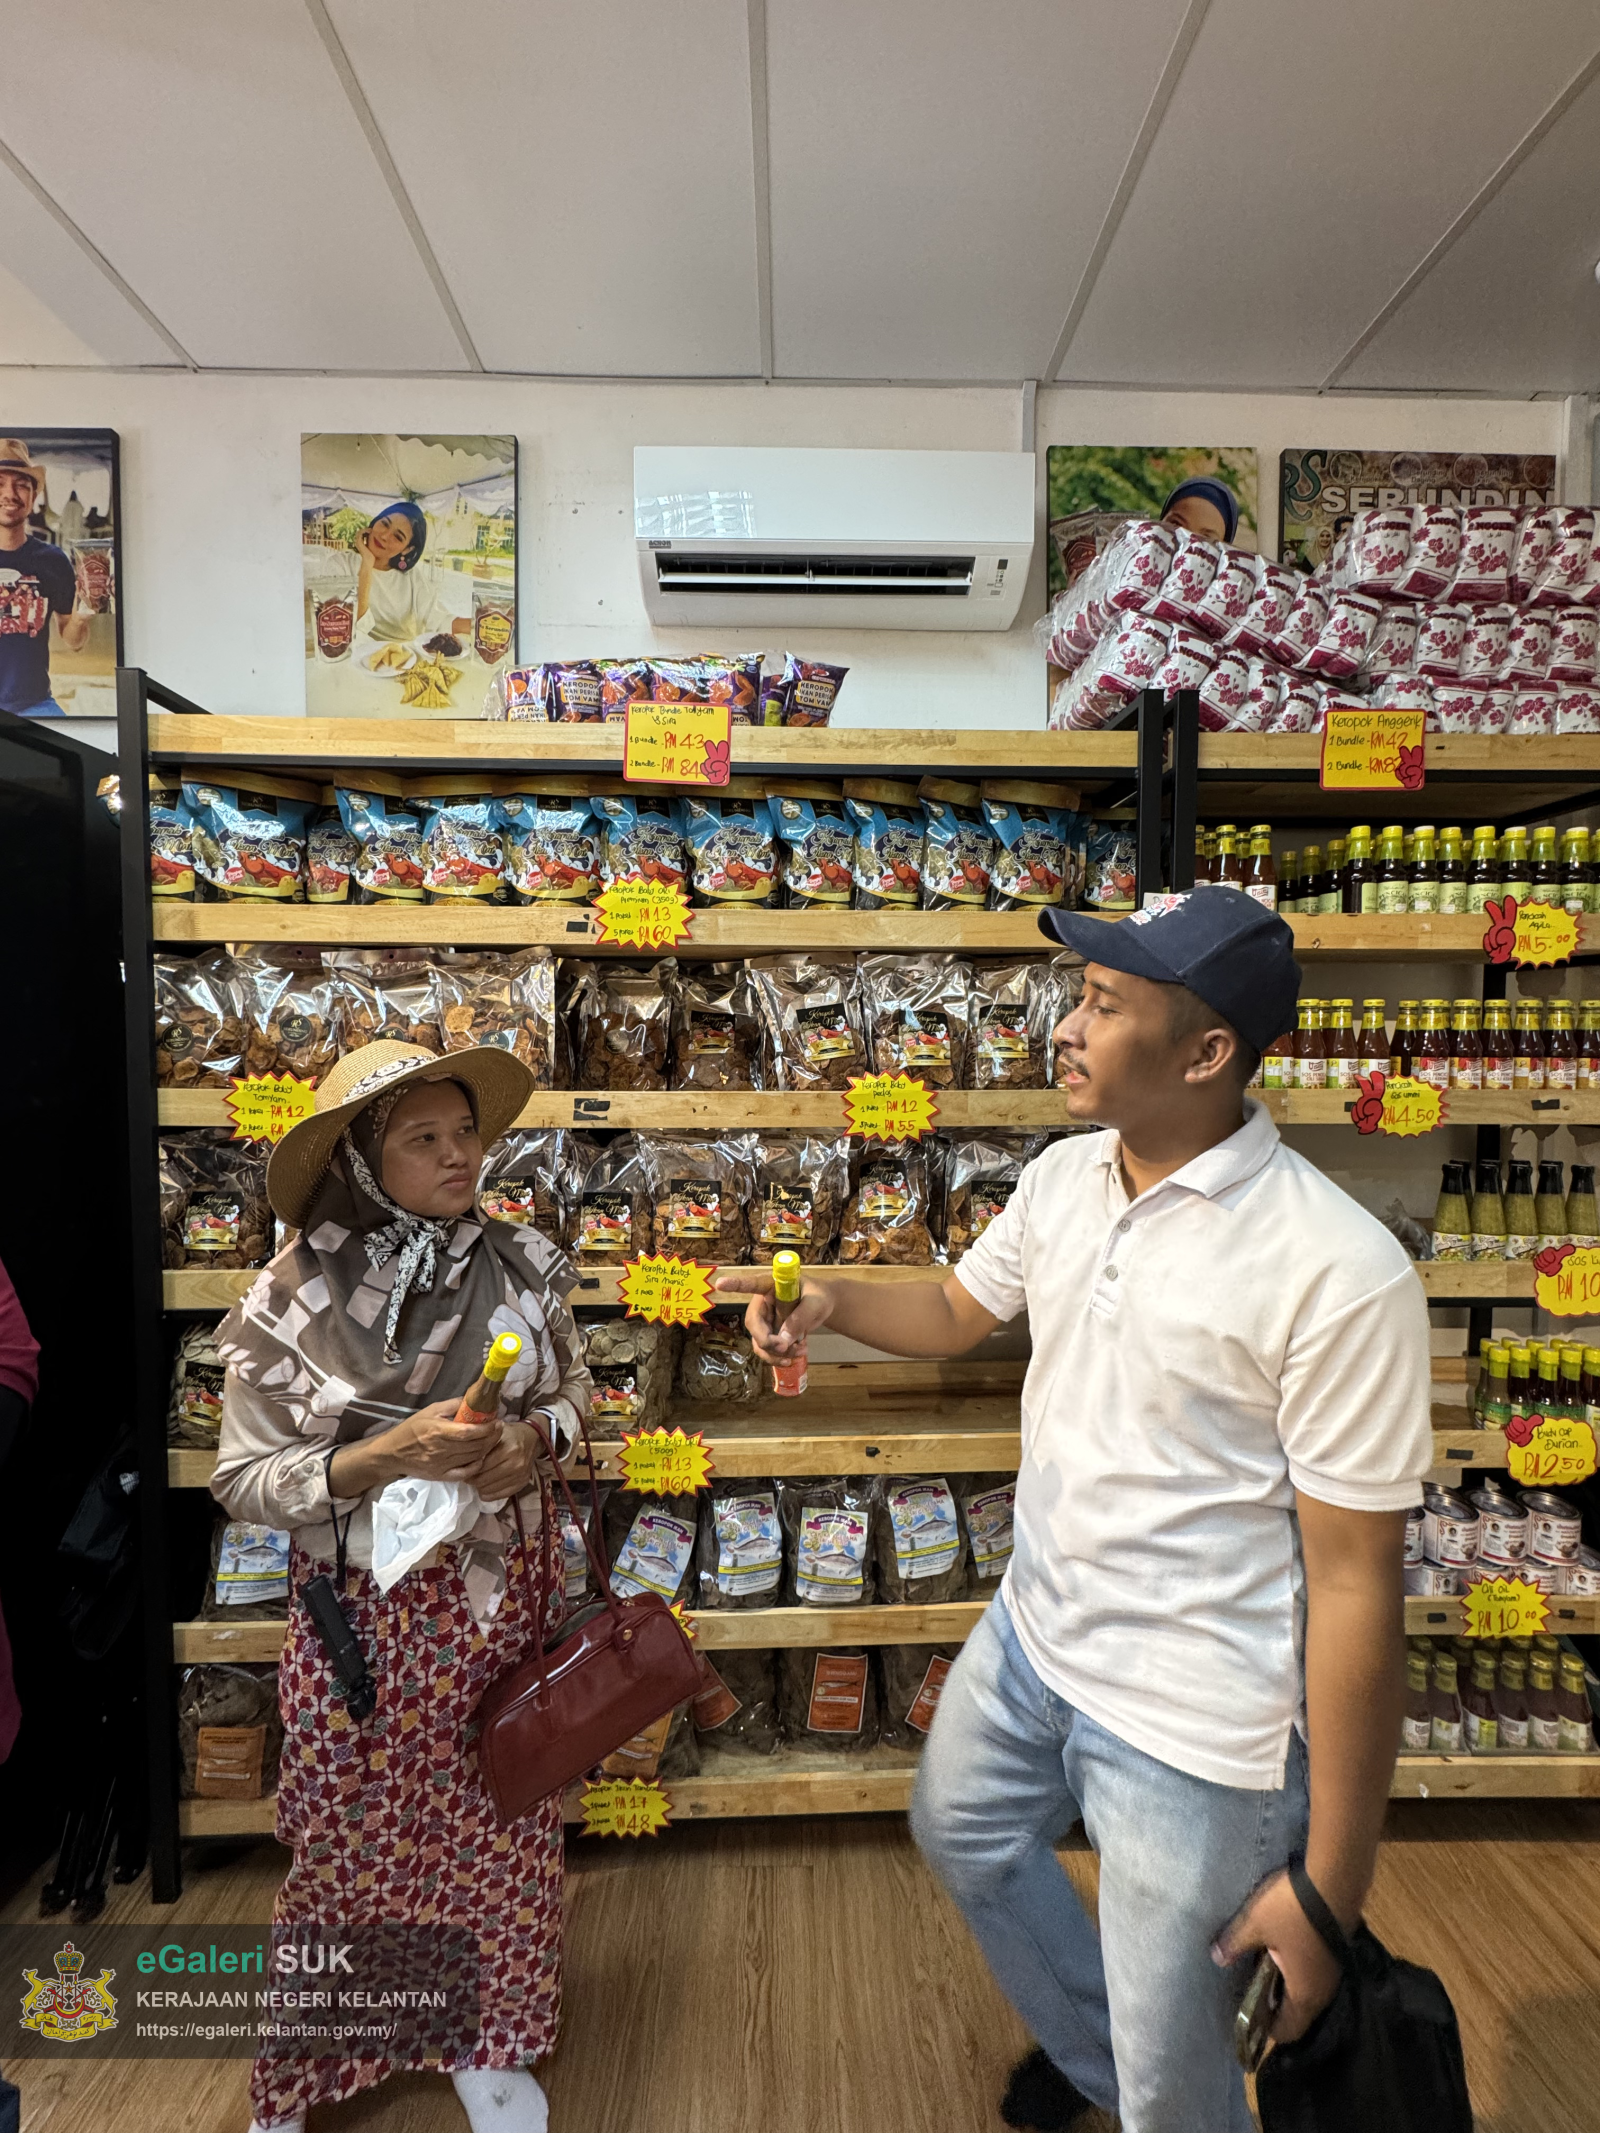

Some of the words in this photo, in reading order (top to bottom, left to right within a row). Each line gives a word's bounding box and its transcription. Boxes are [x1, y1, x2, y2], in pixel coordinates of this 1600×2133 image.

[654, 906, 671, 922] 13
[653, 925, 671, 942] 60
[286, 1105, 304, 1118] 12
[901, 1099, 918, 1113] 12
[898, 1120, 916, 1132] 55
[675, 1288, 693, 1302] 12
[673, 1307, 698, 1319] 55
[675, 1457, 692, 1471] 13
[627, 1813, 650, 1832] 48
